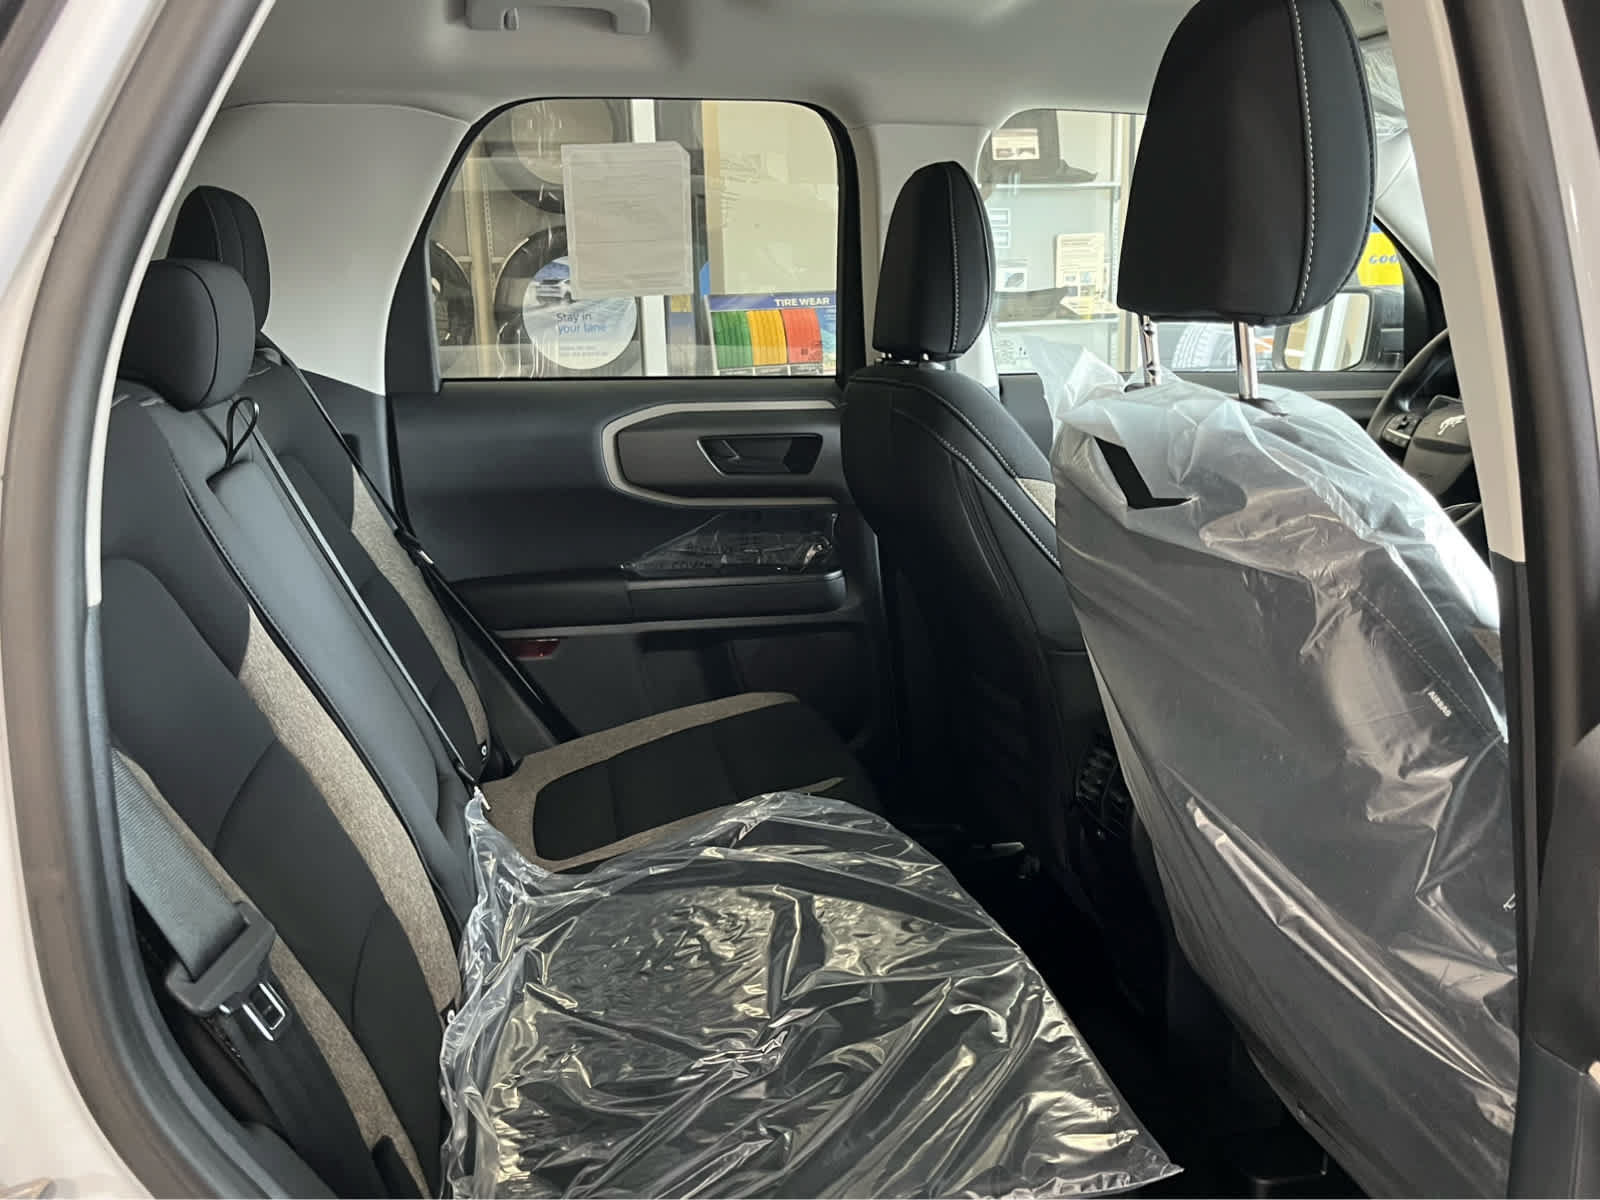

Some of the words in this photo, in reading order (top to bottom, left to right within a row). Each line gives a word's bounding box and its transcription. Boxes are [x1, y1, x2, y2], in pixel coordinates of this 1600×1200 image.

[775, 298, 798, 306] TIRE
[799, 297, 830, 306] WEAR
[556, 312, 578, 323] Stay
[582, 312, 592, 320] in
[559, 325, 580, 335] your
